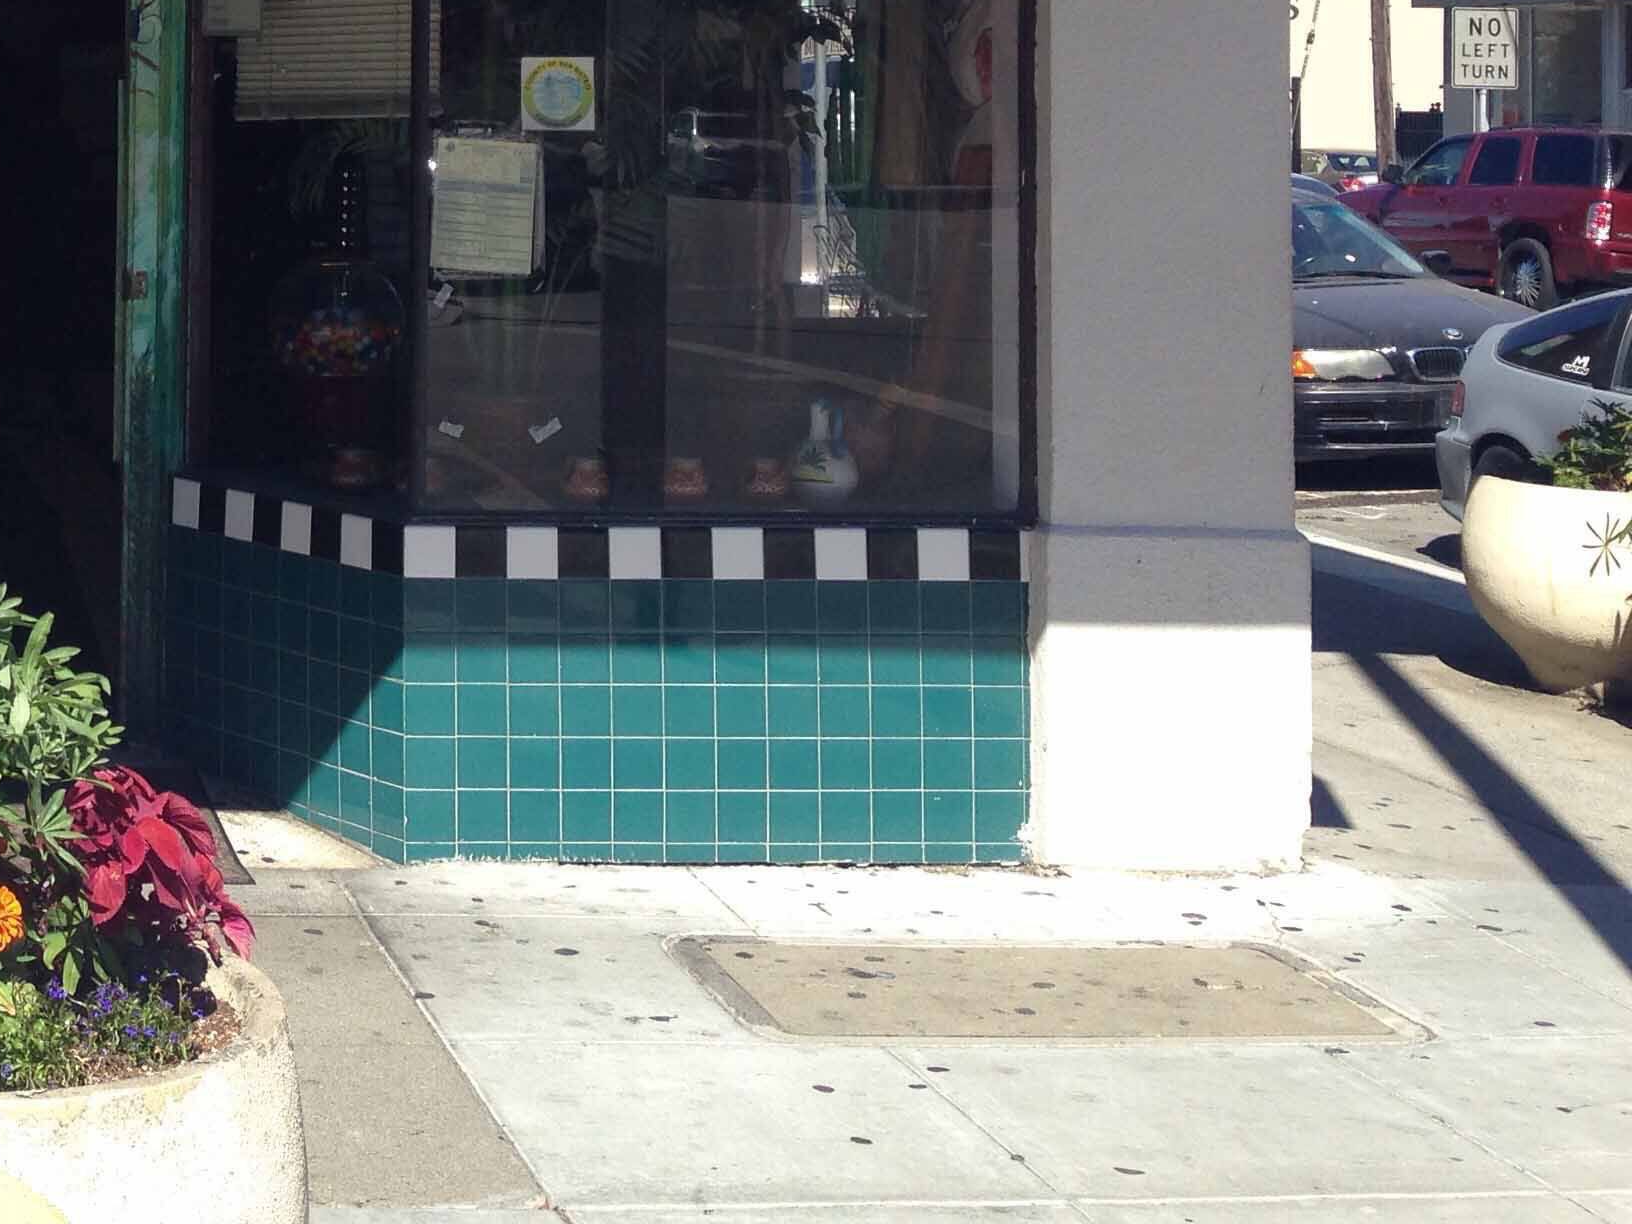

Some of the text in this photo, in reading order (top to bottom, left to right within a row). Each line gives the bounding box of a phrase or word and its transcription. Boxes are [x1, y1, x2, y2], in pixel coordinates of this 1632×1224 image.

[1469, 17, 1501, 37] NO
[1462, 42, 1510, 58] LEFT
[1461, 63, 1509, 80] TURN
